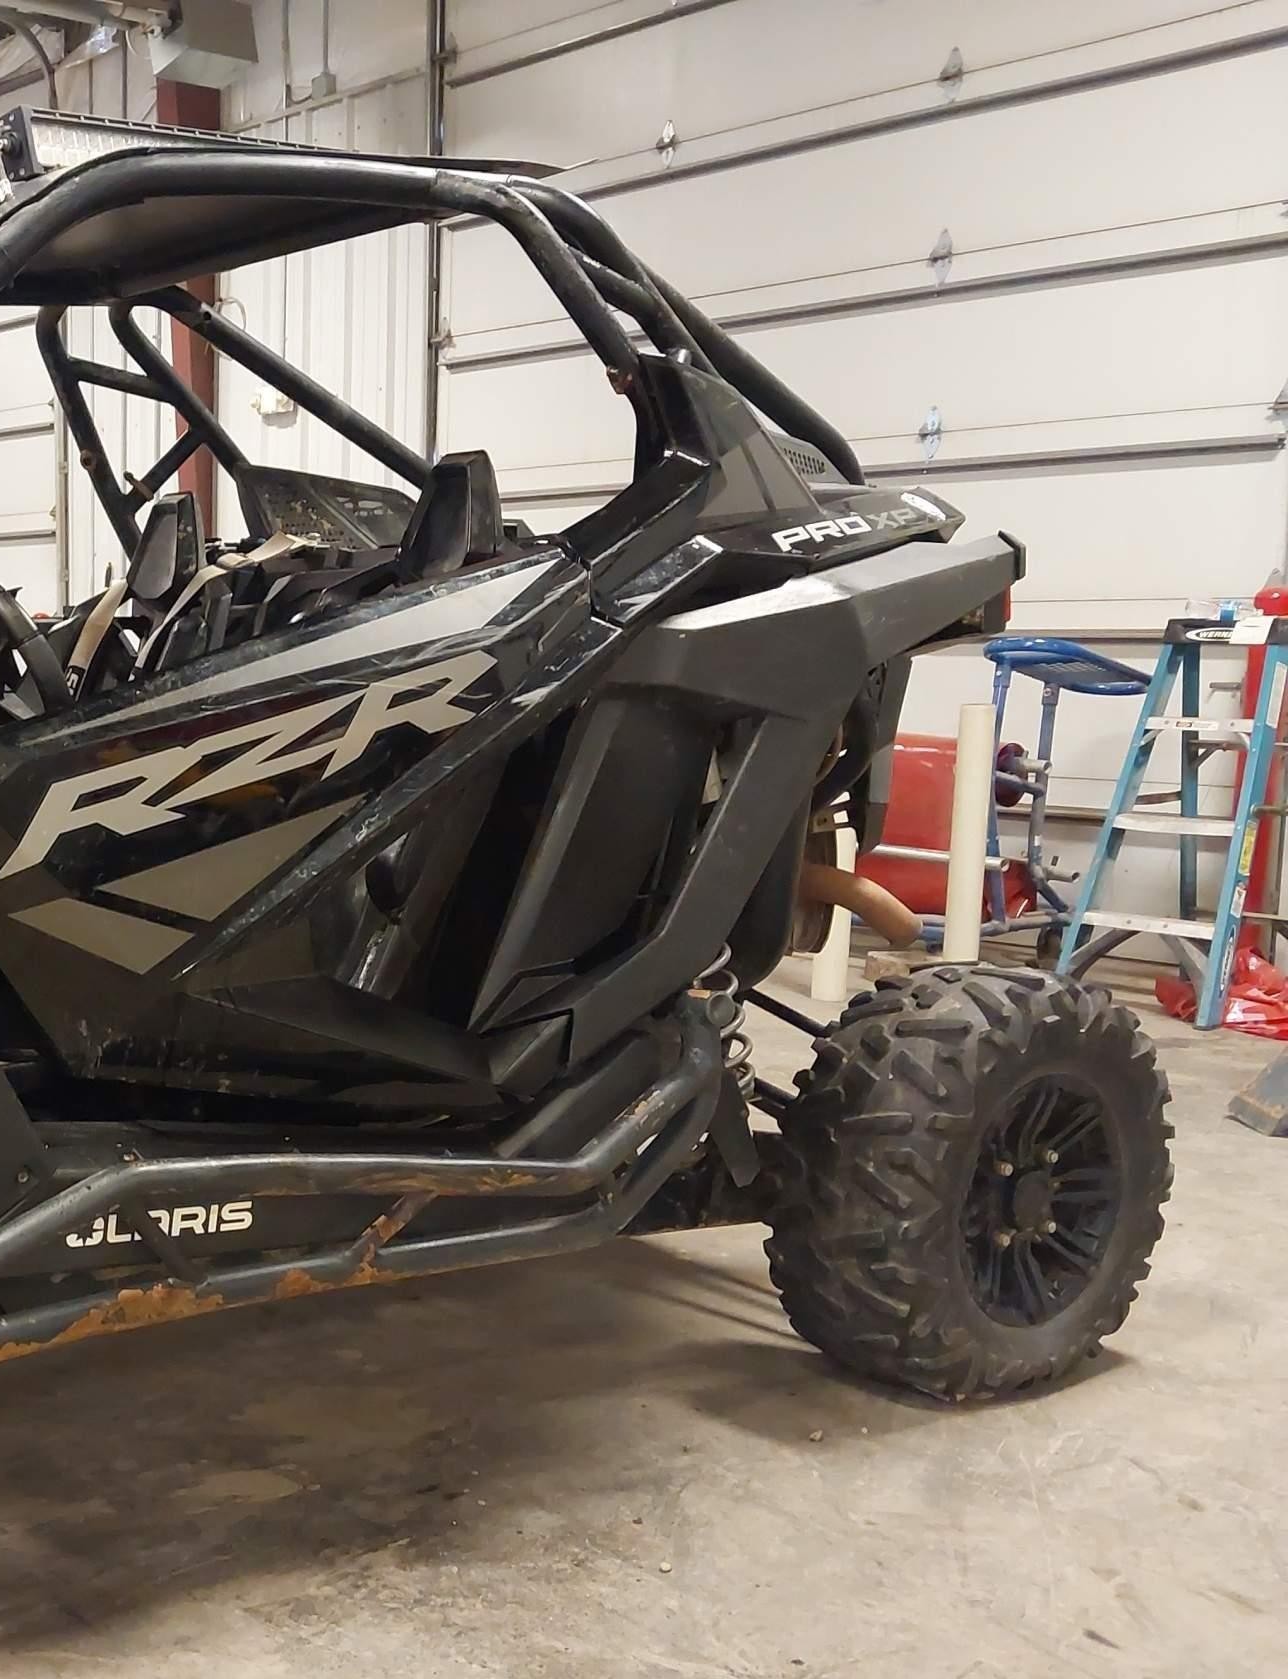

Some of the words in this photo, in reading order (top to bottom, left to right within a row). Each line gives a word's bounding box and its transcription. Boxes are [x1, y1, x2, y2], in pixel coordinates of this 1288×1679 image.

[772, 515, 872, 552] PRO
[866, 508, 917, 530] XP
[1199, 631, 1232, 639] WERN
[65, 1201, 253, 1248] OLRIS
